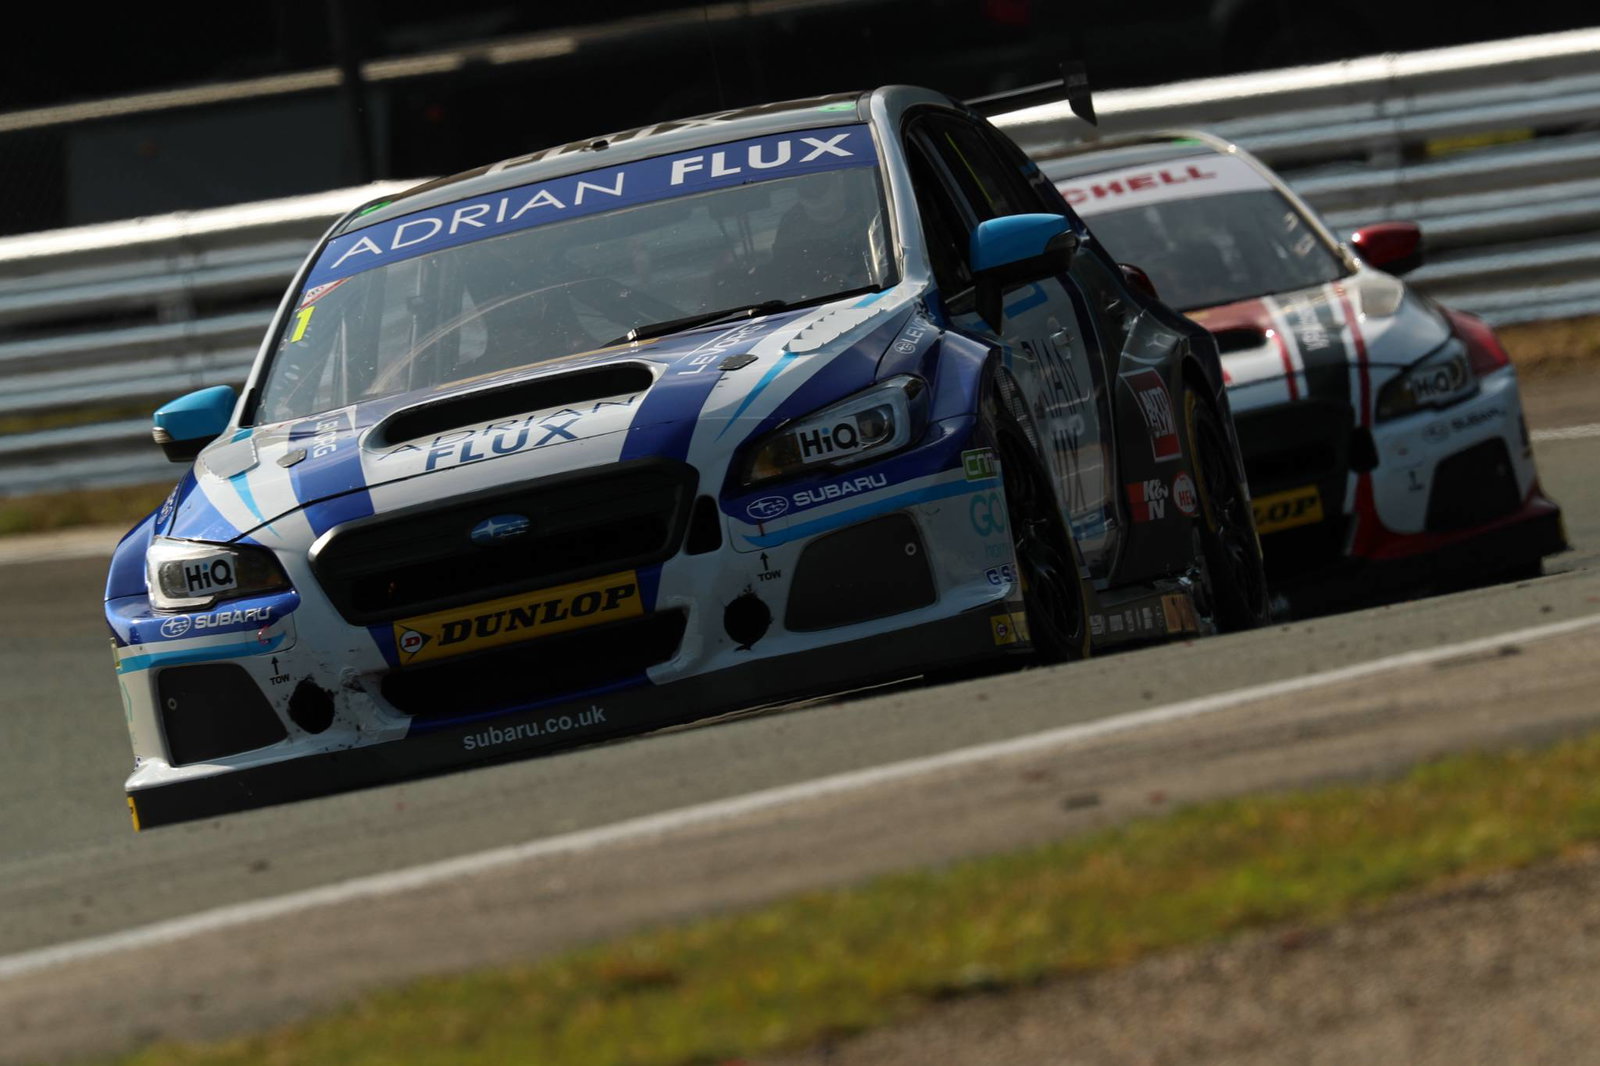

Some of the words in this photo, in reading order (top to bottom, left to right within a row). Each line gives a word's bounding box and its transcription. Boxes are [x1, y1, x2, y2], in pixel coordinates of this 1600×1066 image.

[330, 172, 624, 269] ADRIAN
[670, 133, 853, 185] FLUX
[291, 306, 315, 343] 1
[377, 395, 636, 460] ADRIAN
[425, 419, 580, 470] FLUX
[799, 423, 859, 457] HiQ
[792, 472, 888, 507] SUBARU
[185, 559, 233, 591] HiQ
[758, 569, 781, 581] TOW
[194, 606, 273, 629] SUBARU
[438, 583, 636, 646] DUNLOP
[270, 673, 289, 685] TOW
[463, 705, 607, 750] subaru.co.uk
